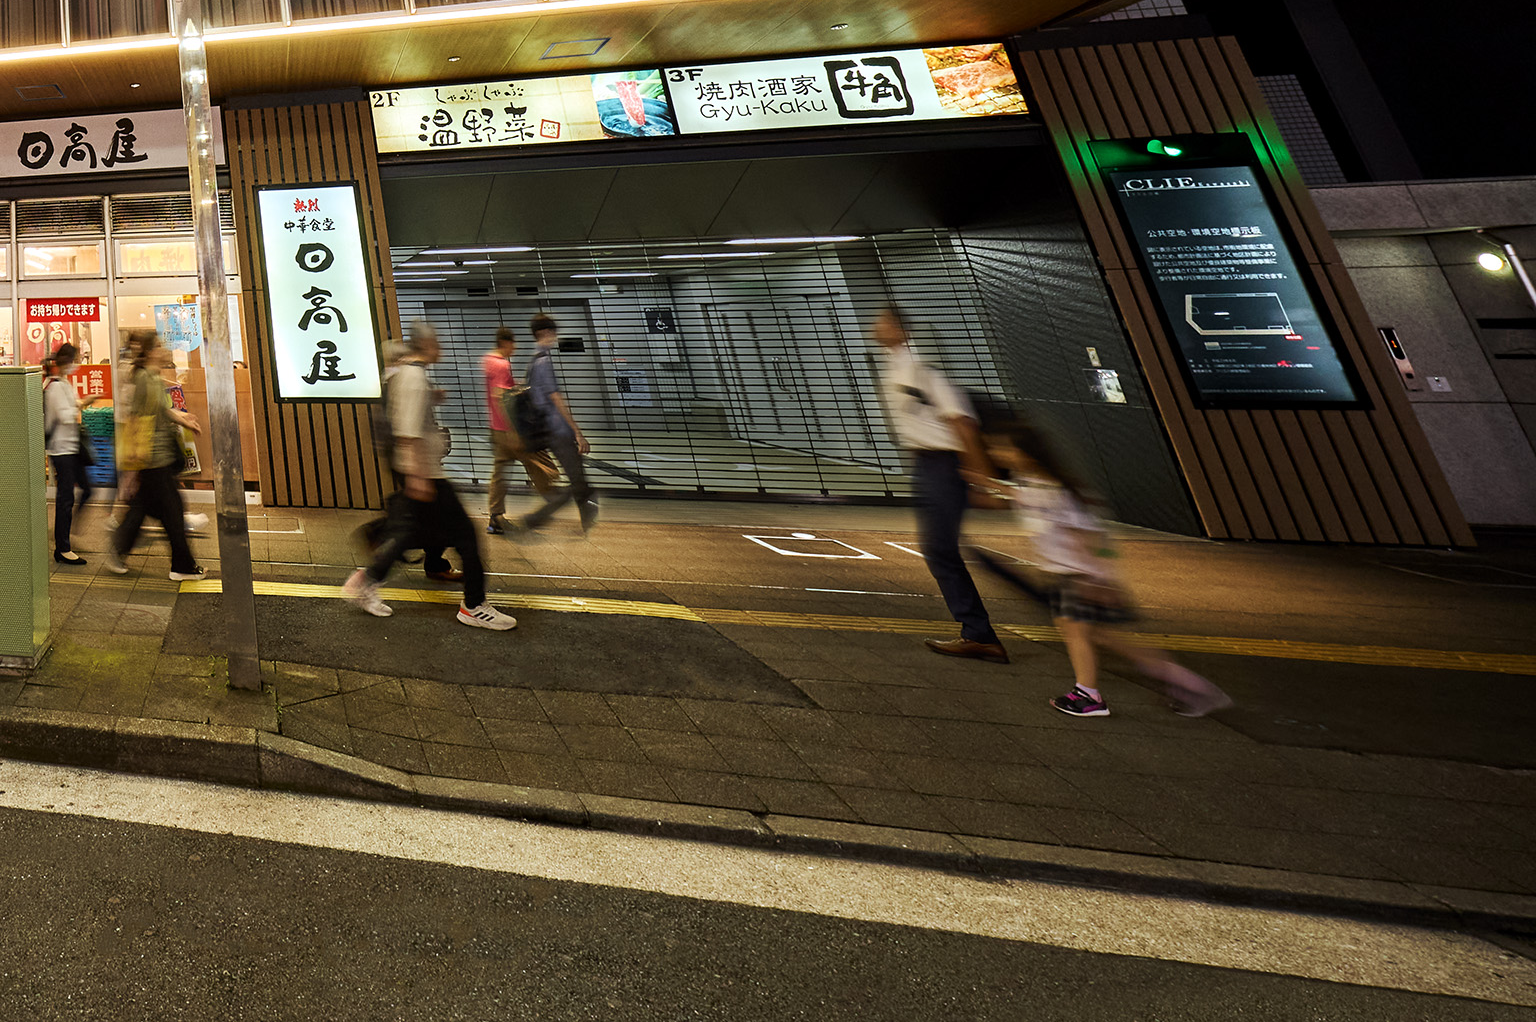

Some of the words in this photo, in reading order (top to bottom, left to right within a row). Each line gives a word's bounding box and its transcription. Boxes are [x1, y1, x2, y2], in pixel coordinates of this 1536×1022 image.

[669, 68, 703, 82] 3F
[435, 83, 524, 104] しゃぶしゃぶ
[695, 75, 822, 101] 焼肉酒家
[841, 69, 903, 104] 牛角
[372, 91, 401, 107] 2F
[700, 97, 828, 121] Gyu-Kaku
[418, 102, 535, 146] 温野菜
[17, 117, 148, 169] 日高屋
[1125, 177, 1195, 191] CLIE
[293, 197, 320, 212] 熱烈
[284, 215, 336, 234] 中華食堂
[30, 303, 96, 317] お持ち帰りできます
[295, 242, 356, 385] 日高屋
[89, 370, 104, 395] 営業中
